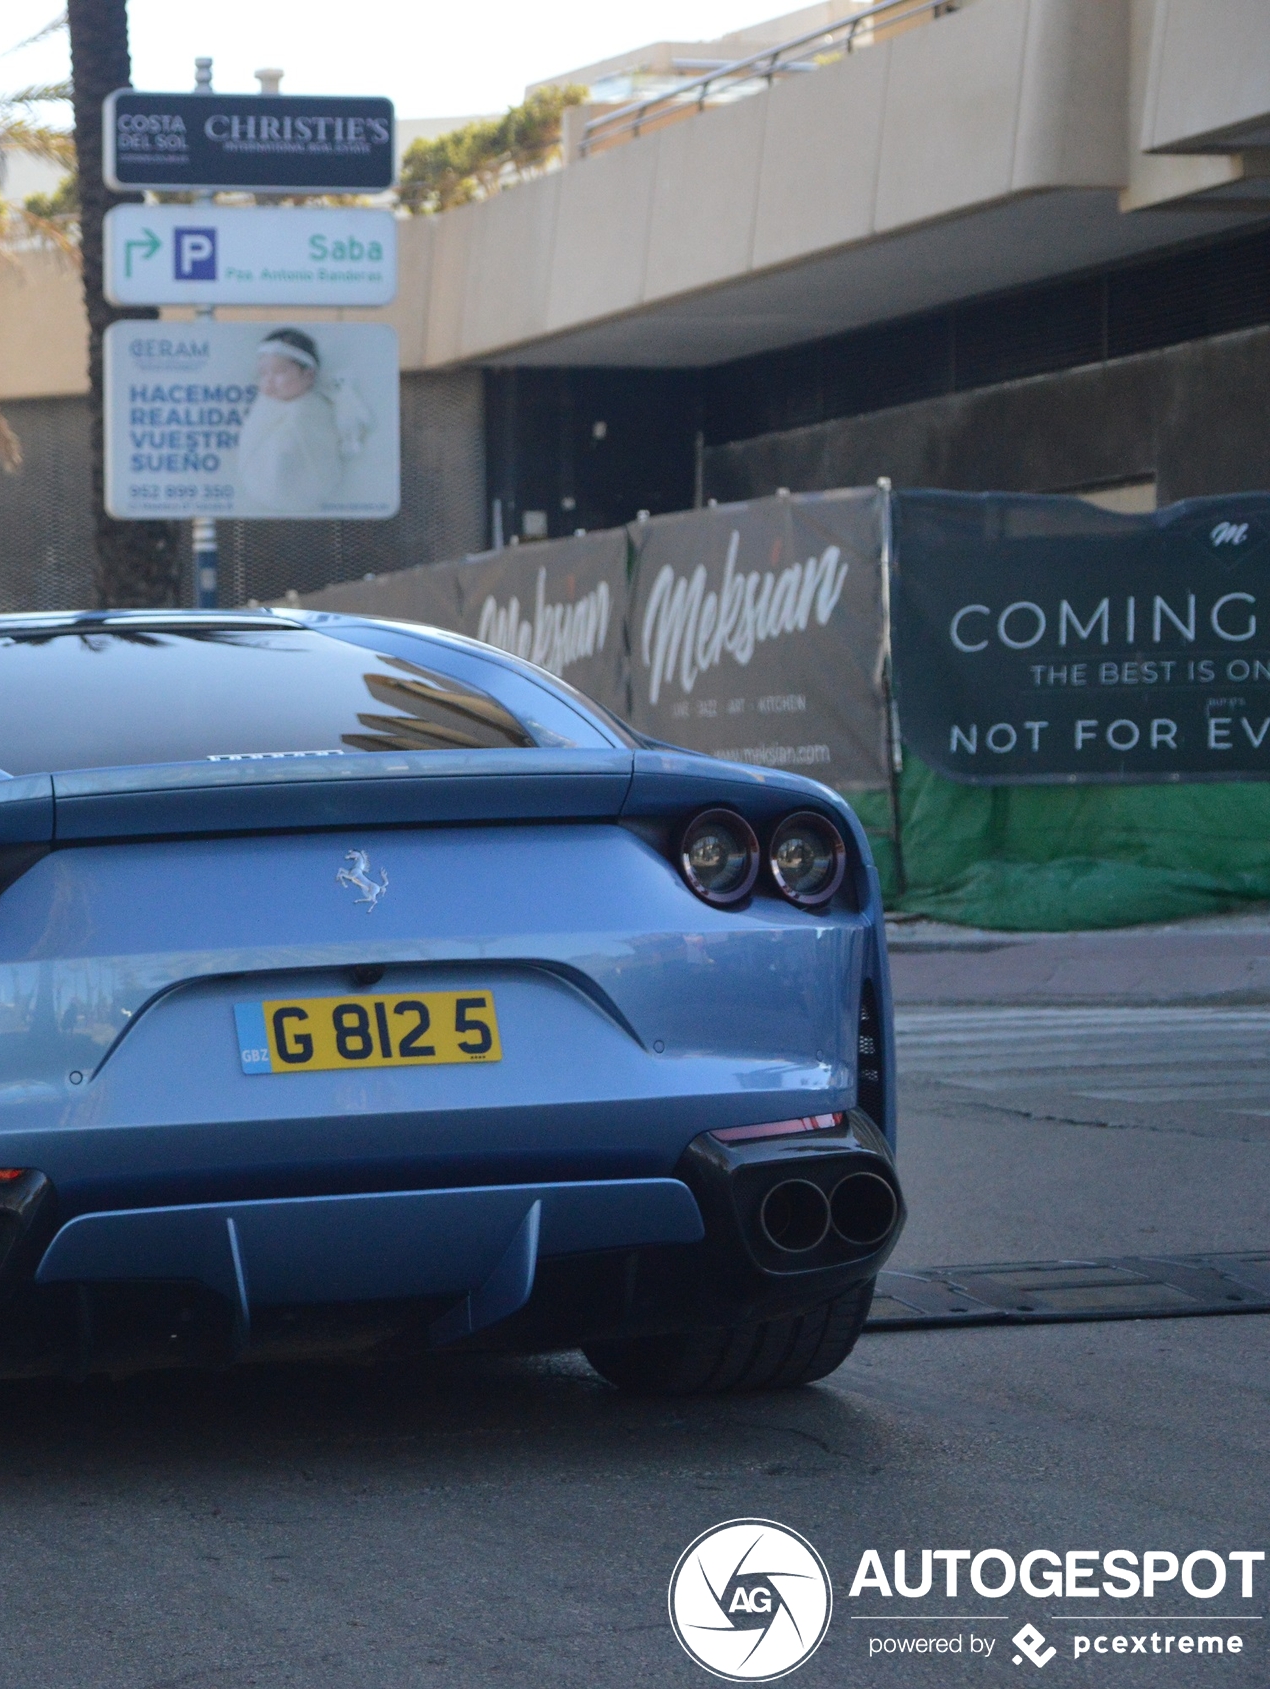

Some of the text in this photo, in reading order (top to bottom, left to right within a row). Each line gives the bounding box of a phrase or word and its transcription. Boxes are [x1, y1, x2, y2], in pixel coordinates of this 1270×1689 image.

[117, 114, 187, 134] COSTA
[204, 114, 390, 145] CHRISTIE'S
[118, 133, 189, 151] DEL SOL
[181, 234, 213, 275] P
[308, 234, 384, 261] Saba
[130, 384, 258, 403] HACEMOS
[130, 407, 250, 426] REALIDA
[130, 484, 159, 498] 952
[641, 529, 849, 705] Meksian
[950, 592, 1257, 652] COMING
[1032, 664, 1087, 687] THE
[1099, 661, 1176, 685] BEST
[1188, 660, 1215, 682] IS
[950, 721, 1049, 754] NOT
[1075, 719, 1177, 750] FOR
[272, 1007, 314, 1063] G
[242, 1049, 269, 1063] GBZ
